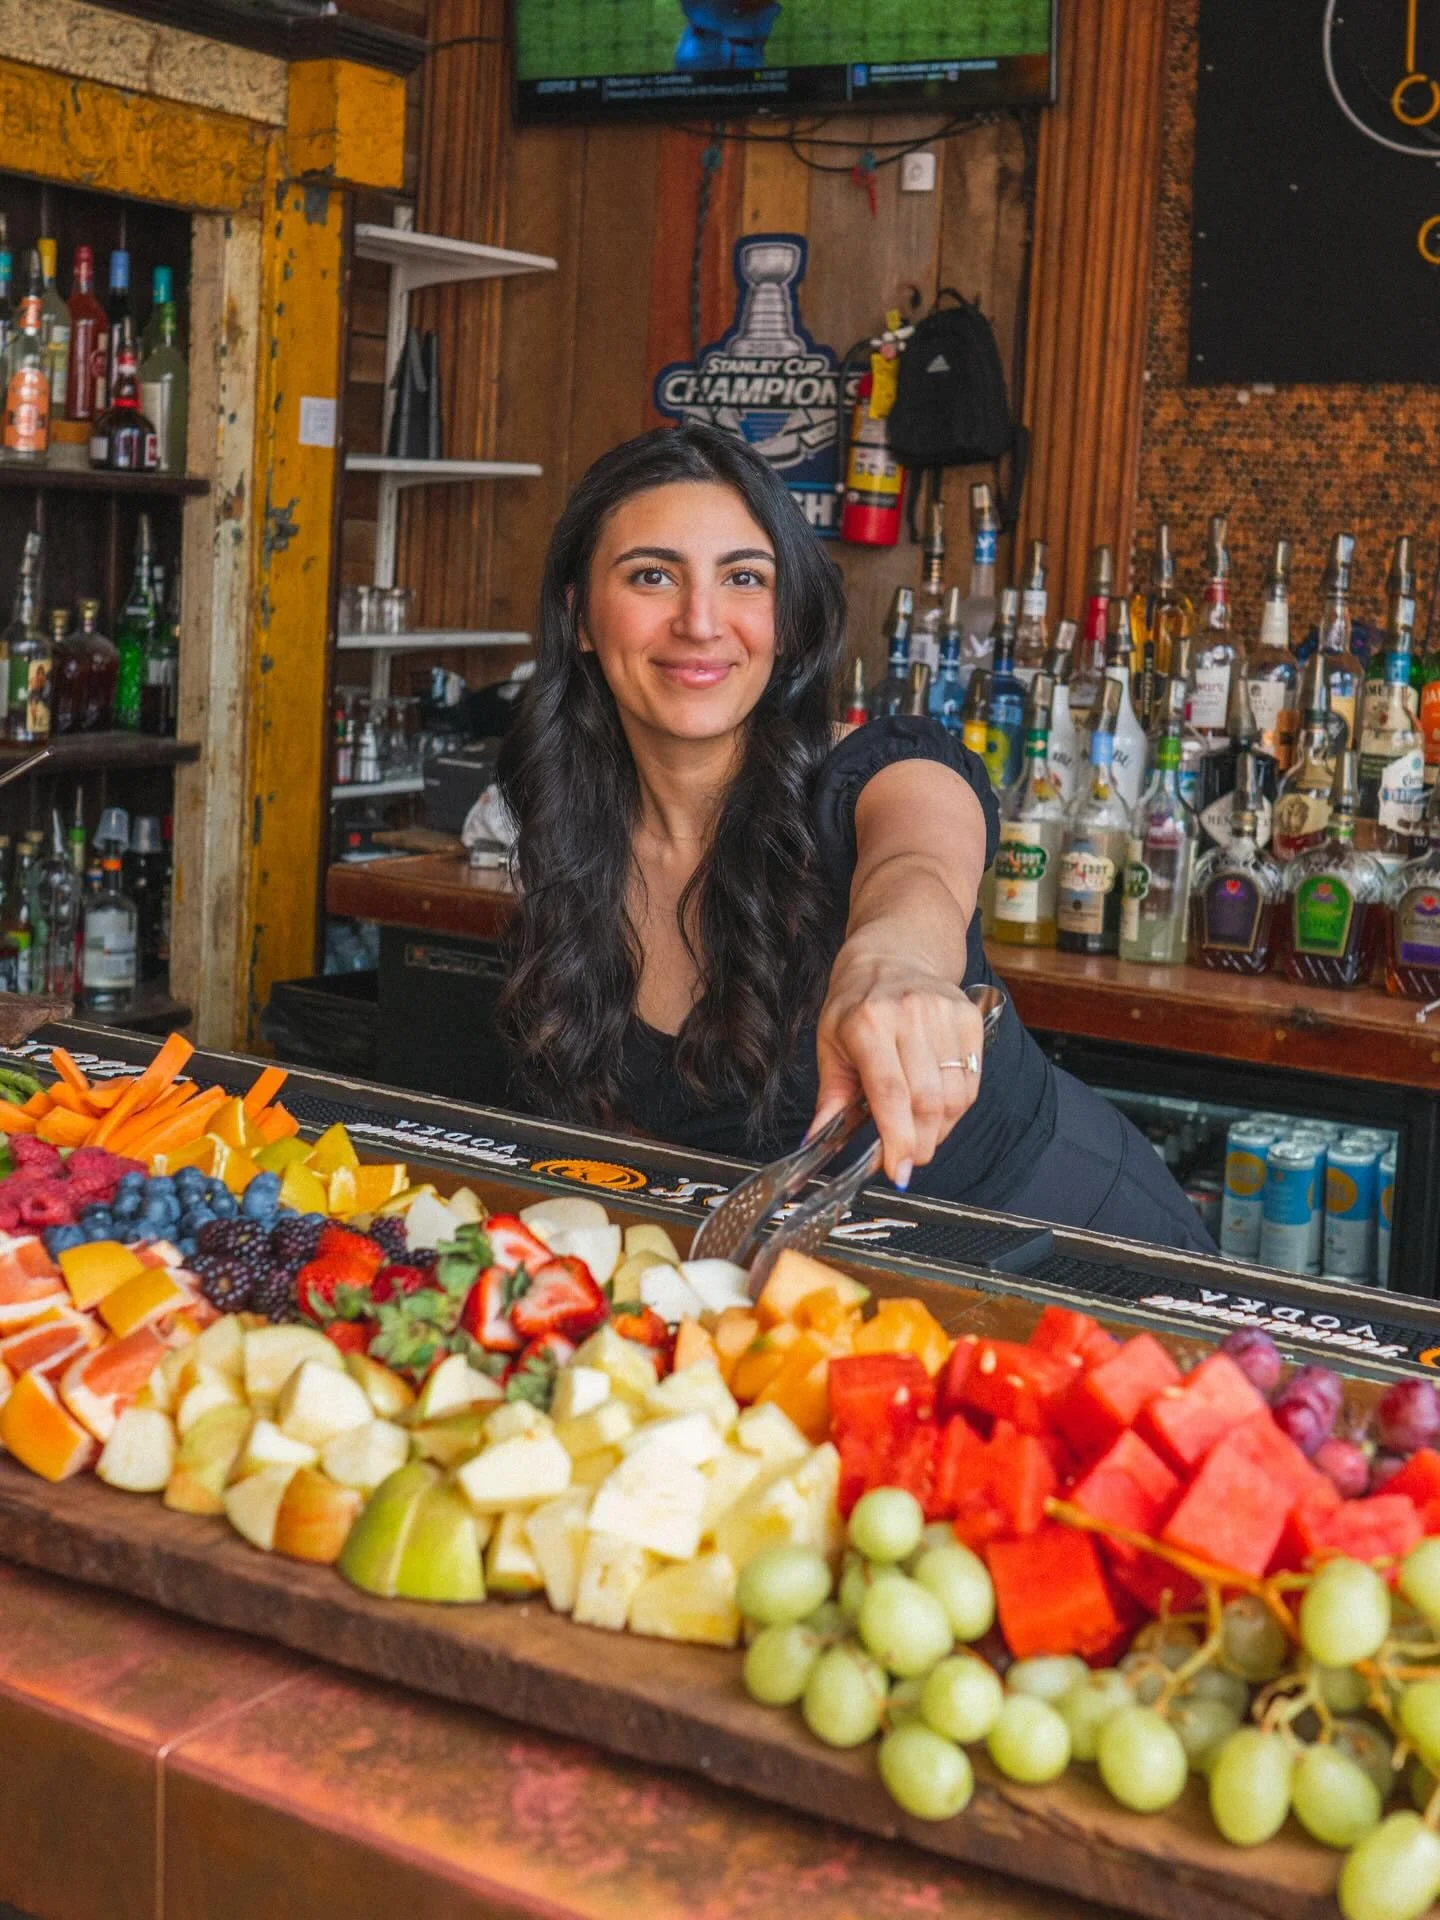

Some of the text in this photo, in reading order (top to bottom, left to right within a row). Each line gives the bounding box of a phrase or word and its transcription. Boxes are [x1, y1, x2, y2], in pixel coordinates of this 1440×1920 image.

[707, 357, 824, 376] STANLEY CUP
[395, 1119, 518, 1155] VODKA
[1199, 1288, 1378, 1341] VODKA
